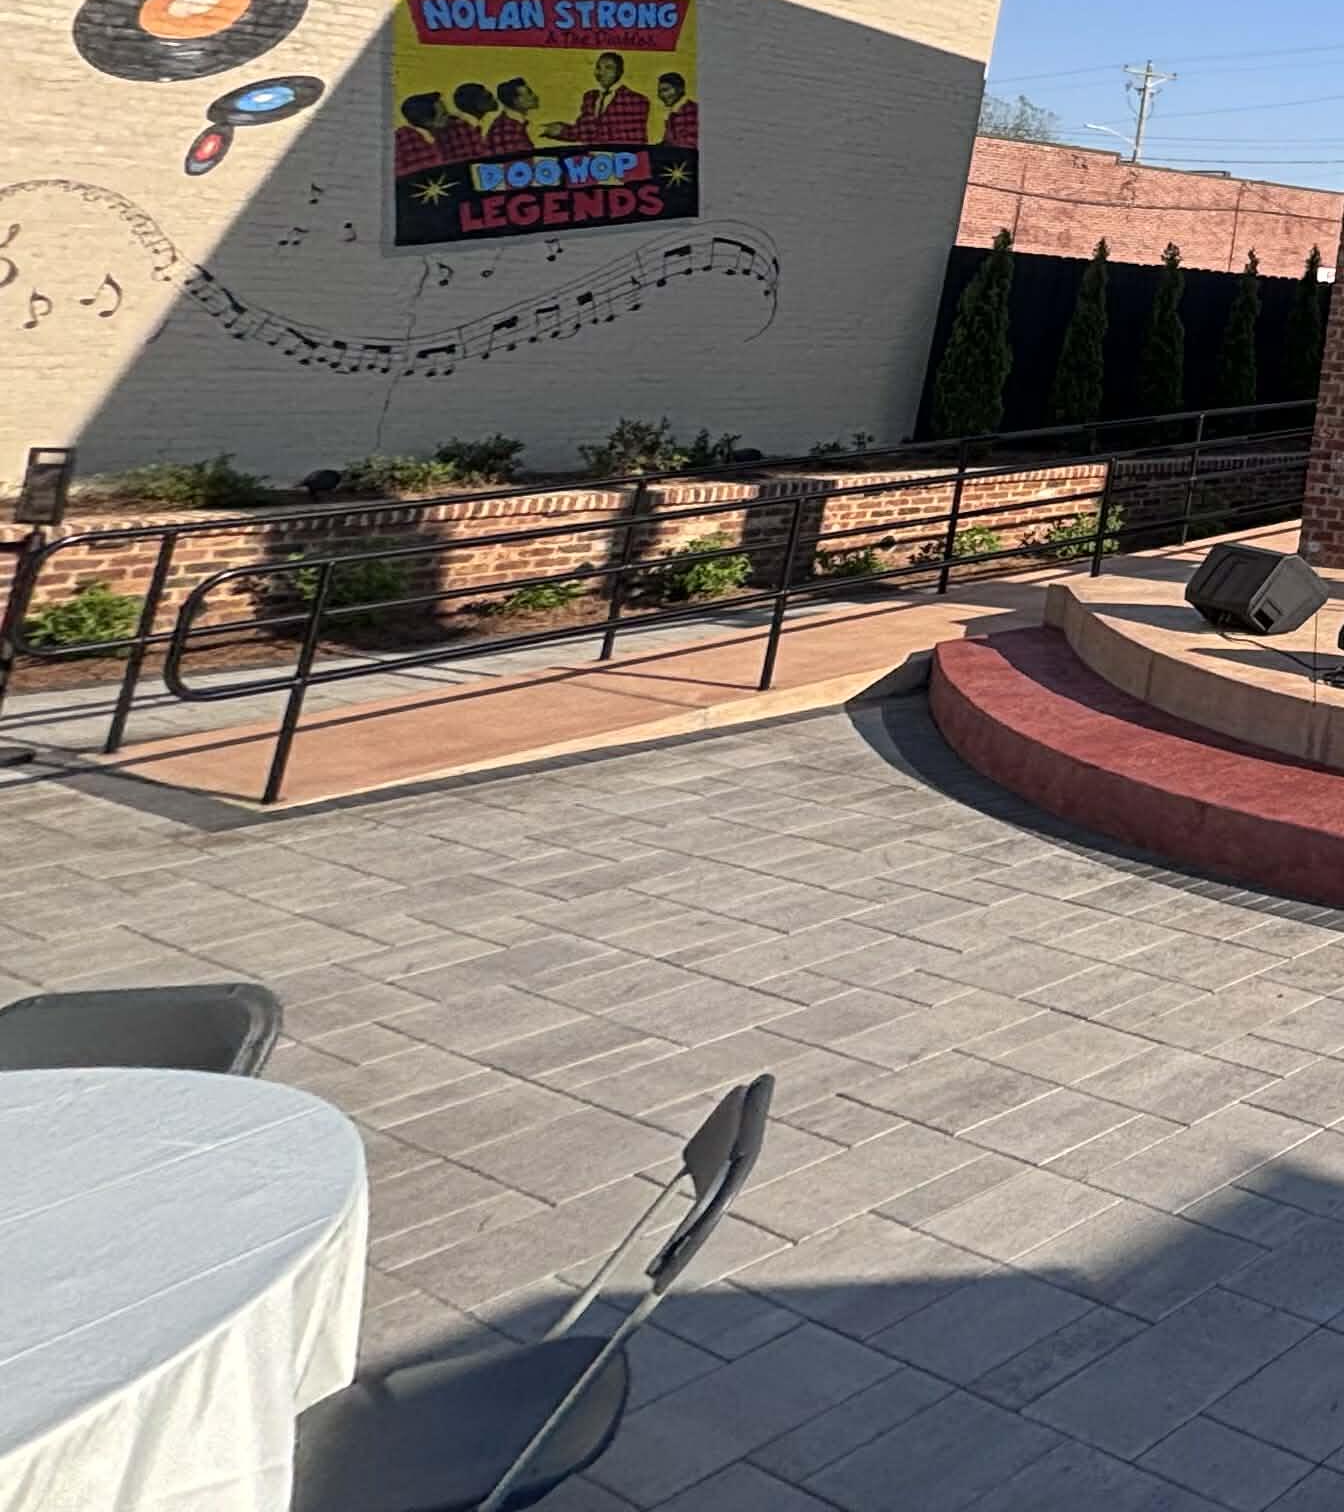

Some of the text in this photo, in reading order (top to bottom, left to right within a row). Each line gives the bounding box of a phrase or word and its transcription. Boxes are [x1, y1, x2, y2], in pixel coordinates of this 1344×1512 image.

[475, 151, 640, 191] DOO WOP
[459, 186, 665, 233] LEGENDS
